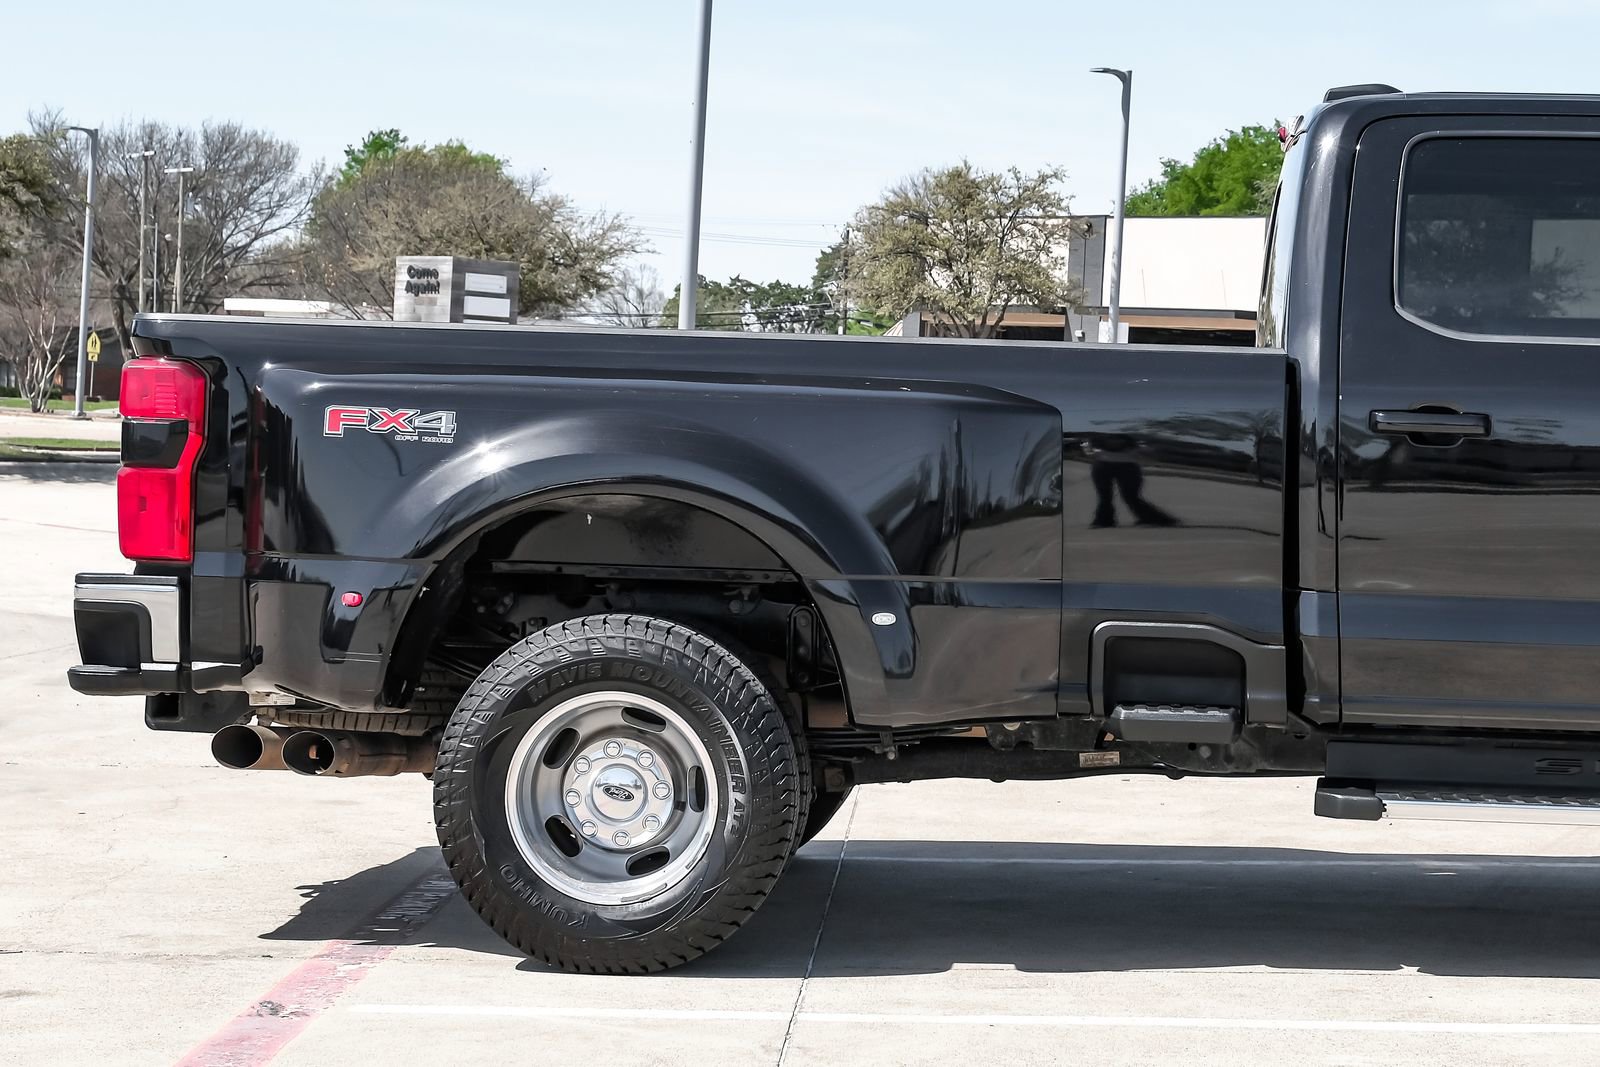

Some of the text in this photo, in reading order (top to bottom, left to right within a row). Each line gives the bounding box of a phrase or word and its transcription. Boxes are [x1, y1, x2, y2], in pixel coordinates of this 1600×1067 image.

[323, 405, 456, 437] FX4
[527, 662, 602, 704] MAVIS
[610, 662, 746, 794] MOUNTAINEER
[606, 786, 631, 800] Ford
[499, 864, 591, 930] KUMHO
